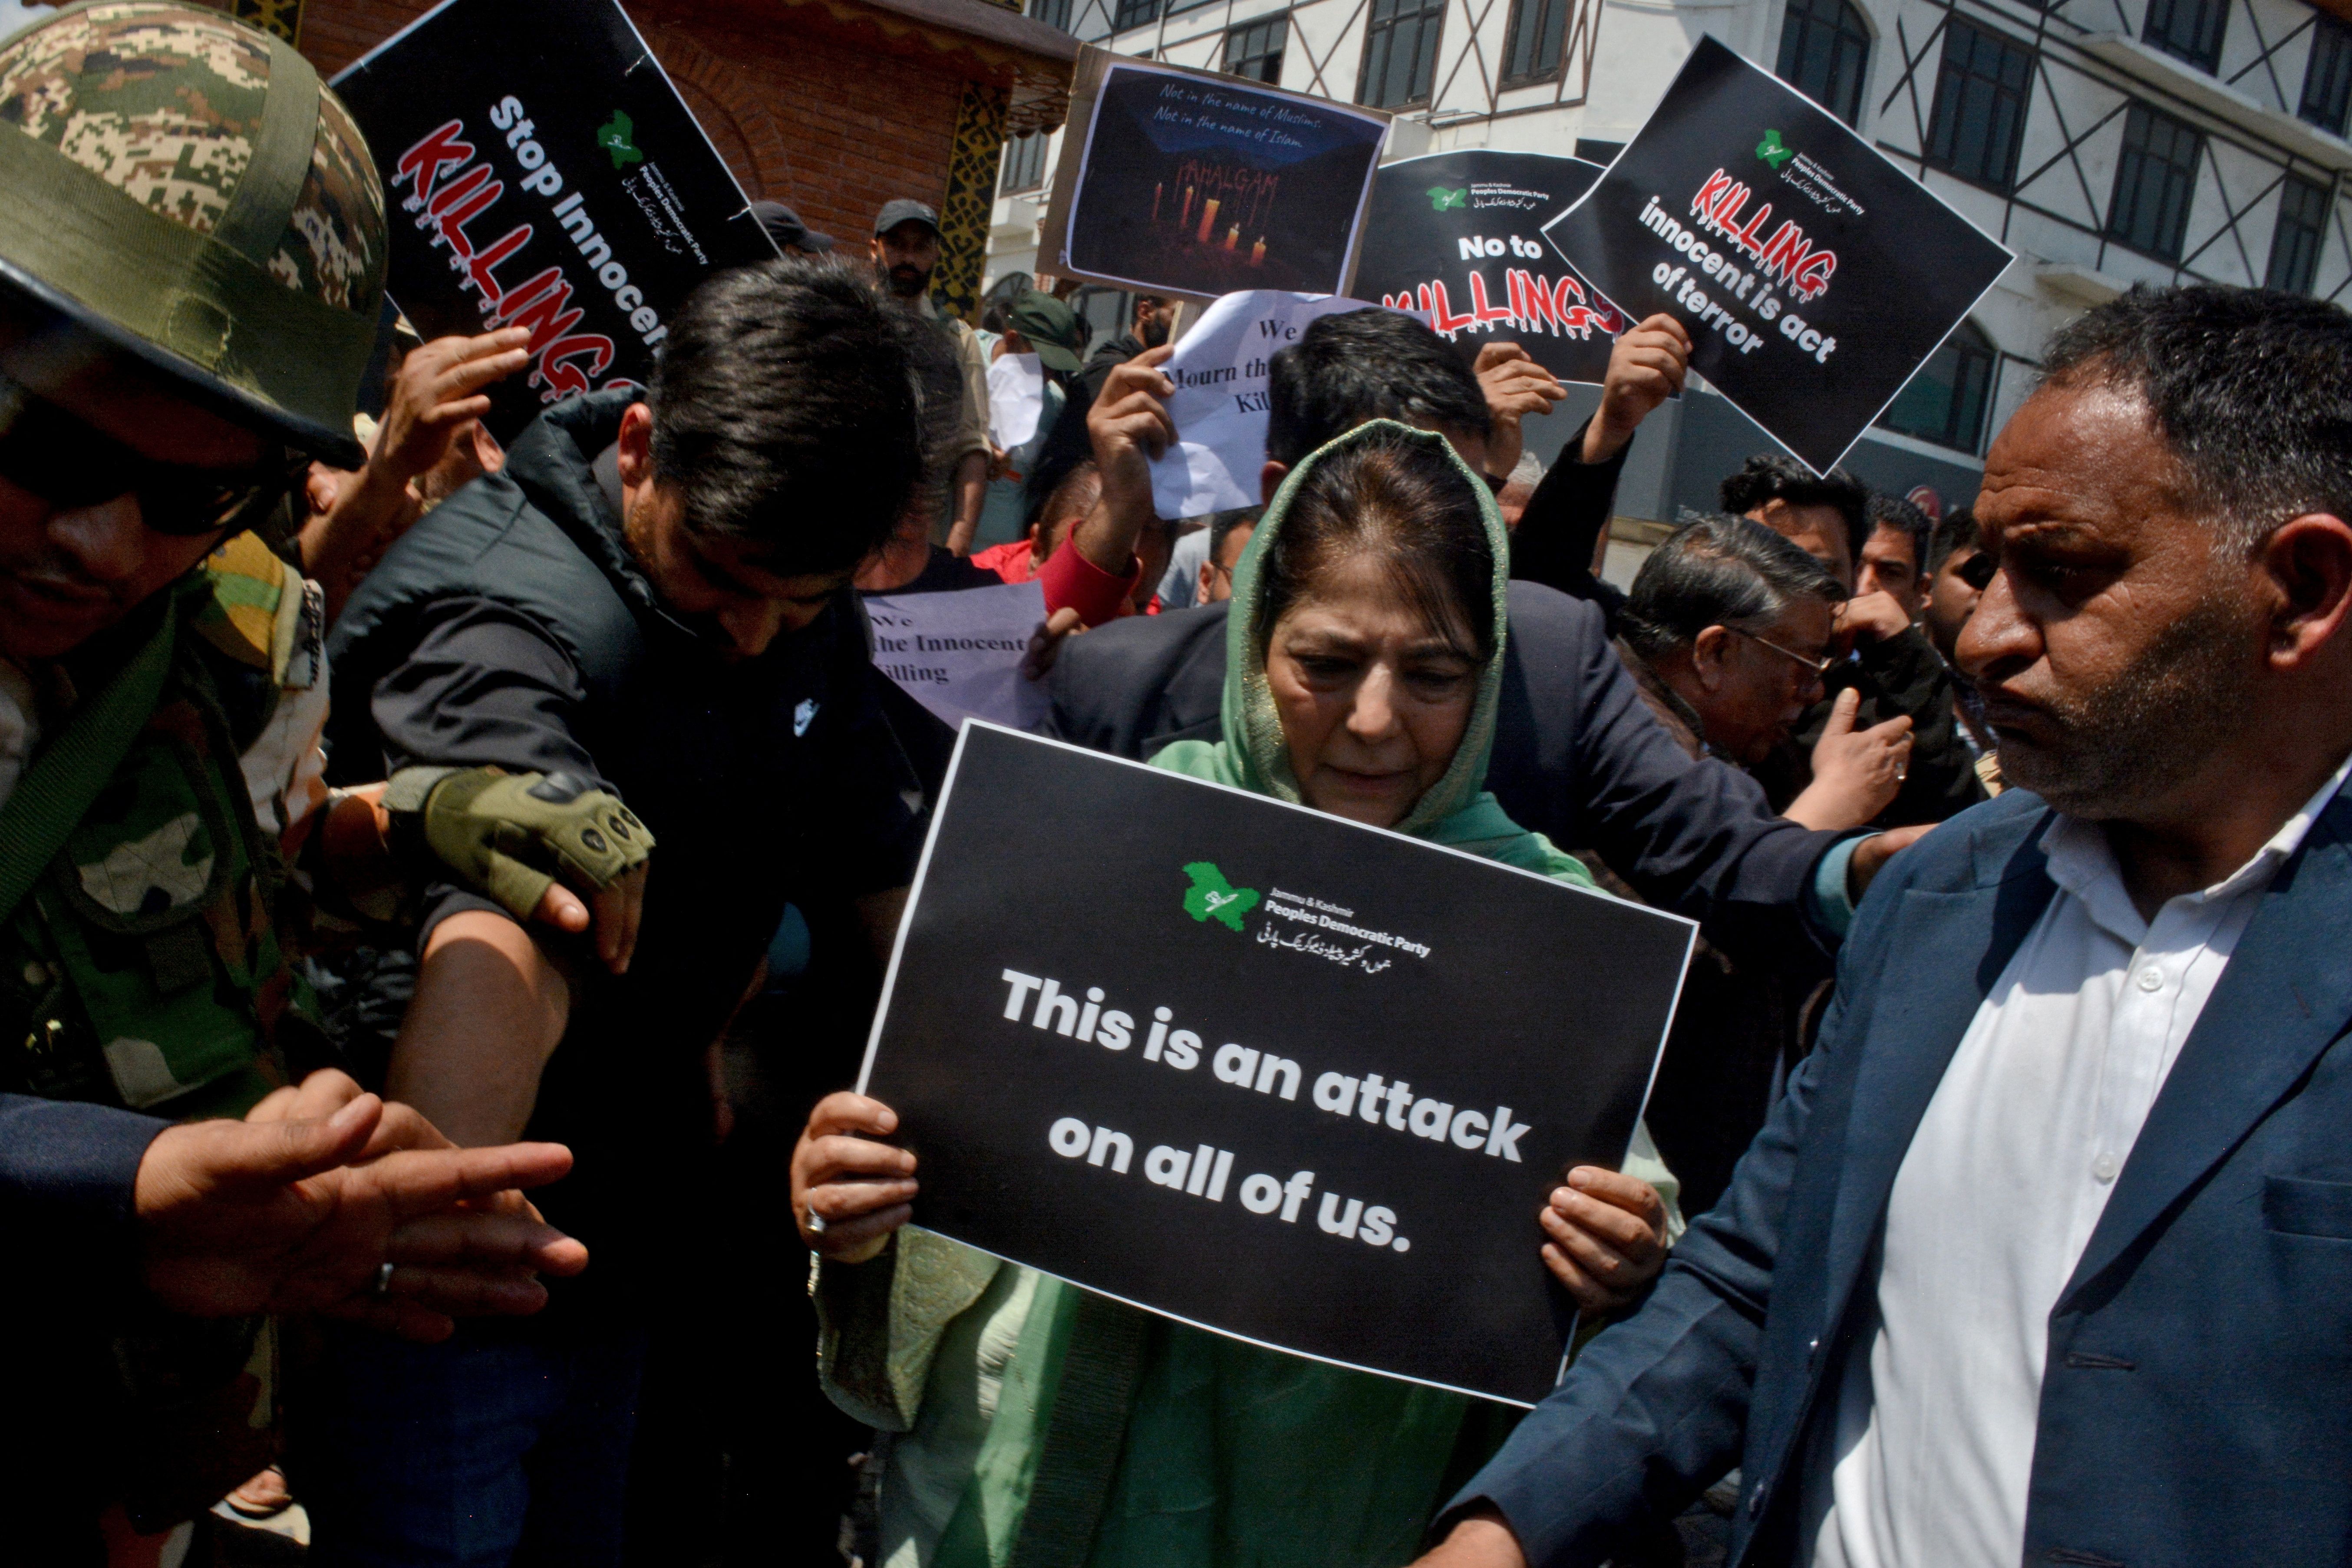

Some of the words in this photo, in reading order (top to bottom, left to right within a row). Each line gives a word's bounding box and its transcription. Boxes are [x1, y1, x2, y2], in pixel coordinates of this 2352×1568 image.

[1154, 106, 1177, 122] Not
[1181, 113, 1192, 125] in
[1196, 115, 1216, 130] the
[1220, 124, 1250, 138] name
[1255, 128, 1270, 142] of
[1160, 84, 1182, 100] Not
[1187, 91, 1197, 102] in
[1202, 93, 1221, 107] the
[1225, 101, 1257, 115] name
[1260, 105, 1276, 119] of
[640, 165, 663, 199] Peoples
[661, 198, 693, 244] Democratic
[691, 242, 708, 264] Party
[1533, 191, 1549, 200] Party
[1791, 157, 1815, 177] Peoples
[1814, 174, 1847, 202] Democratic
[1847, 199, 1864, 215] Party
[490, 95, 563, 196] Stop
[552, 191, 668, 359] Innocen
[1458, 235, 1505, 261] No
[1509, 234, 1543, 260] to
[1689, 168, 1837, 304] KILLING
[391, 119, 646, 403] KILLING
[1639, 195, 1755, 300] innocent
[1748, 282, 1781, 320] is
[1780, 314, 1837, 364] act
[1260, 320, 1297, 340] We
[1382, 268, 1625, 343] ILLINGS
[1653, 263, 1687, 292] of
[1676, 277, 1765, 354] terror
[1245, 358, 1266, 378] th
[874, 635, 908, 652] he
[916, 634, 1026, 652] Innocent
[877, 664, 949, 685] illing
[1265, 900, 1318, 924] Peoples
[1318, 915, 1394, 946] Democratic
[1394, 936, 1431, 958] Party
[1270, 888, 1306, 904] Jammu
[1315, 900, 1354, 917] Kashmir
[1002, 969, 1135, 1052] This
[1143, 1007, 1203, 1071] is
[1213, 1042, 1302, 1102] an
[1313, 1070, 1532, 1163] attack
[1049, 1117, 1134, 1174] on
[1145, 1144, 1234, 1202] all
[1239, 1171, 1316, 1223] of
[1316, 1192, 1410, 1253] us.
